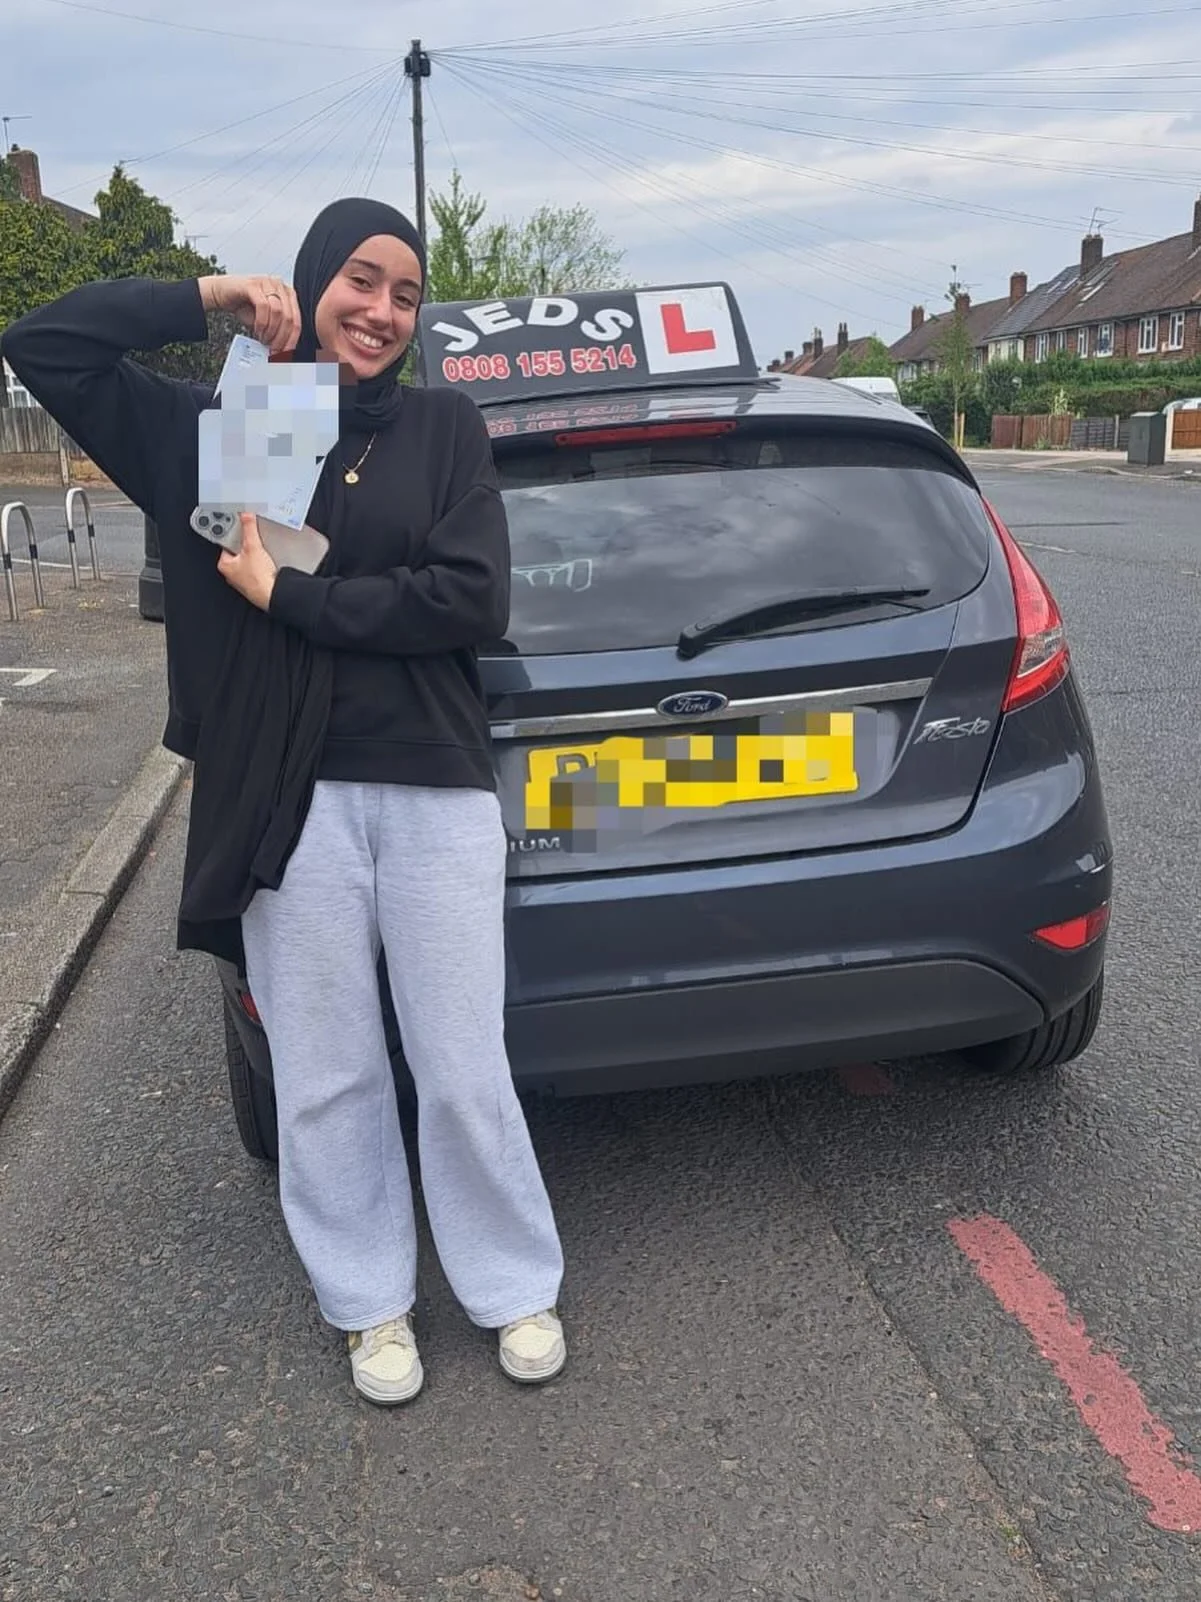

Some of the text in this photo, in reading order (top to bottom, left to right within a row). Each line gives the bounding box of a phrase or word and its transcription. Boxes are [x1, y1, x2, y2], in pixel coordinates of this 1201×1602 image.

[431, 298, 634, 352] JEDS
[660, 303, 717, 354] L
[442, 344, 636, 382] 0808 155 5214
[673, 696, 711, 713] Ford
